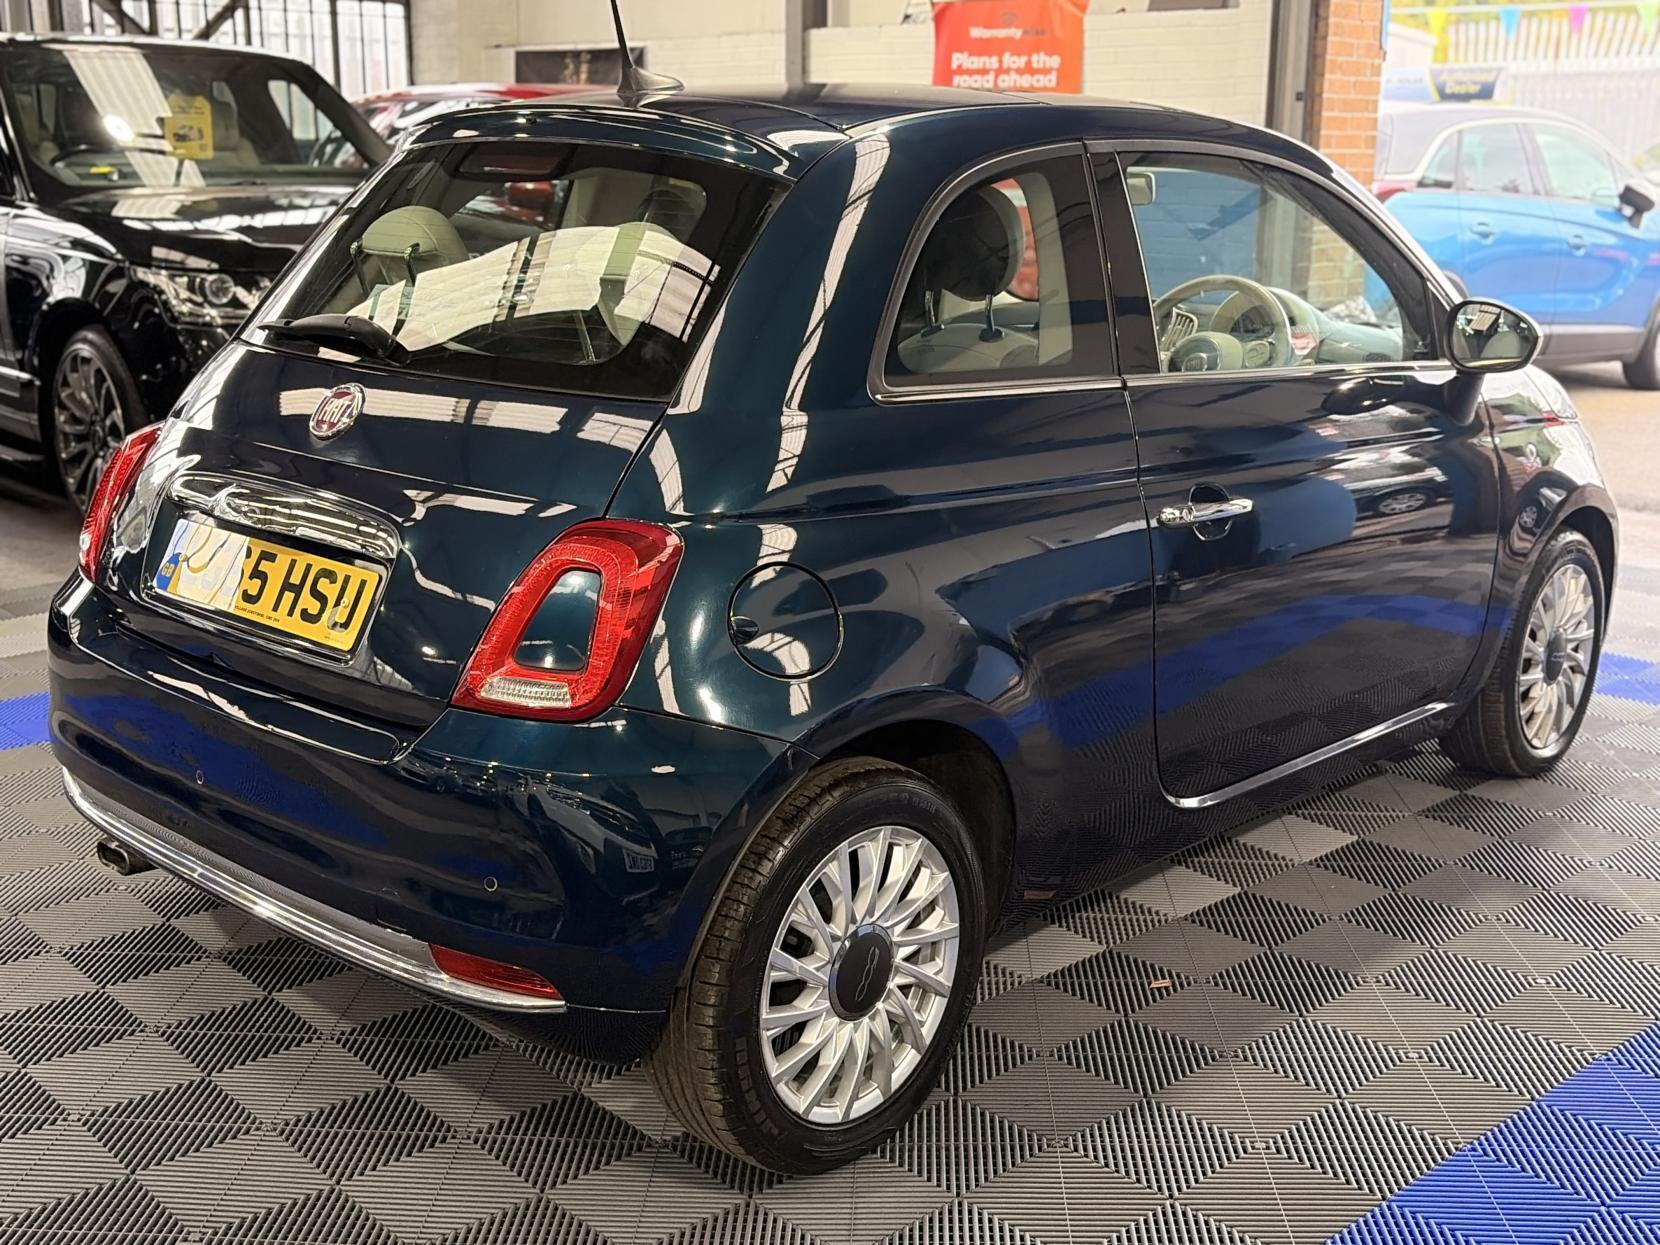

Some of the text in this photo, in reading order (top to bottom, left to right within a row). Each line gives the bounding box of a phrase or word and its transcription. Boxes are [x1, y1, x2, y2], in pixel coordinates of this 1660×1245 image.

[951, 52, 1061, 70] Plans for the
[952, 70, 1057, 88] road ahead
[318, 397, 352, 423] FIAT
[161, 562, 175, 577] GB
[272, 558, 368, 632] HSU
